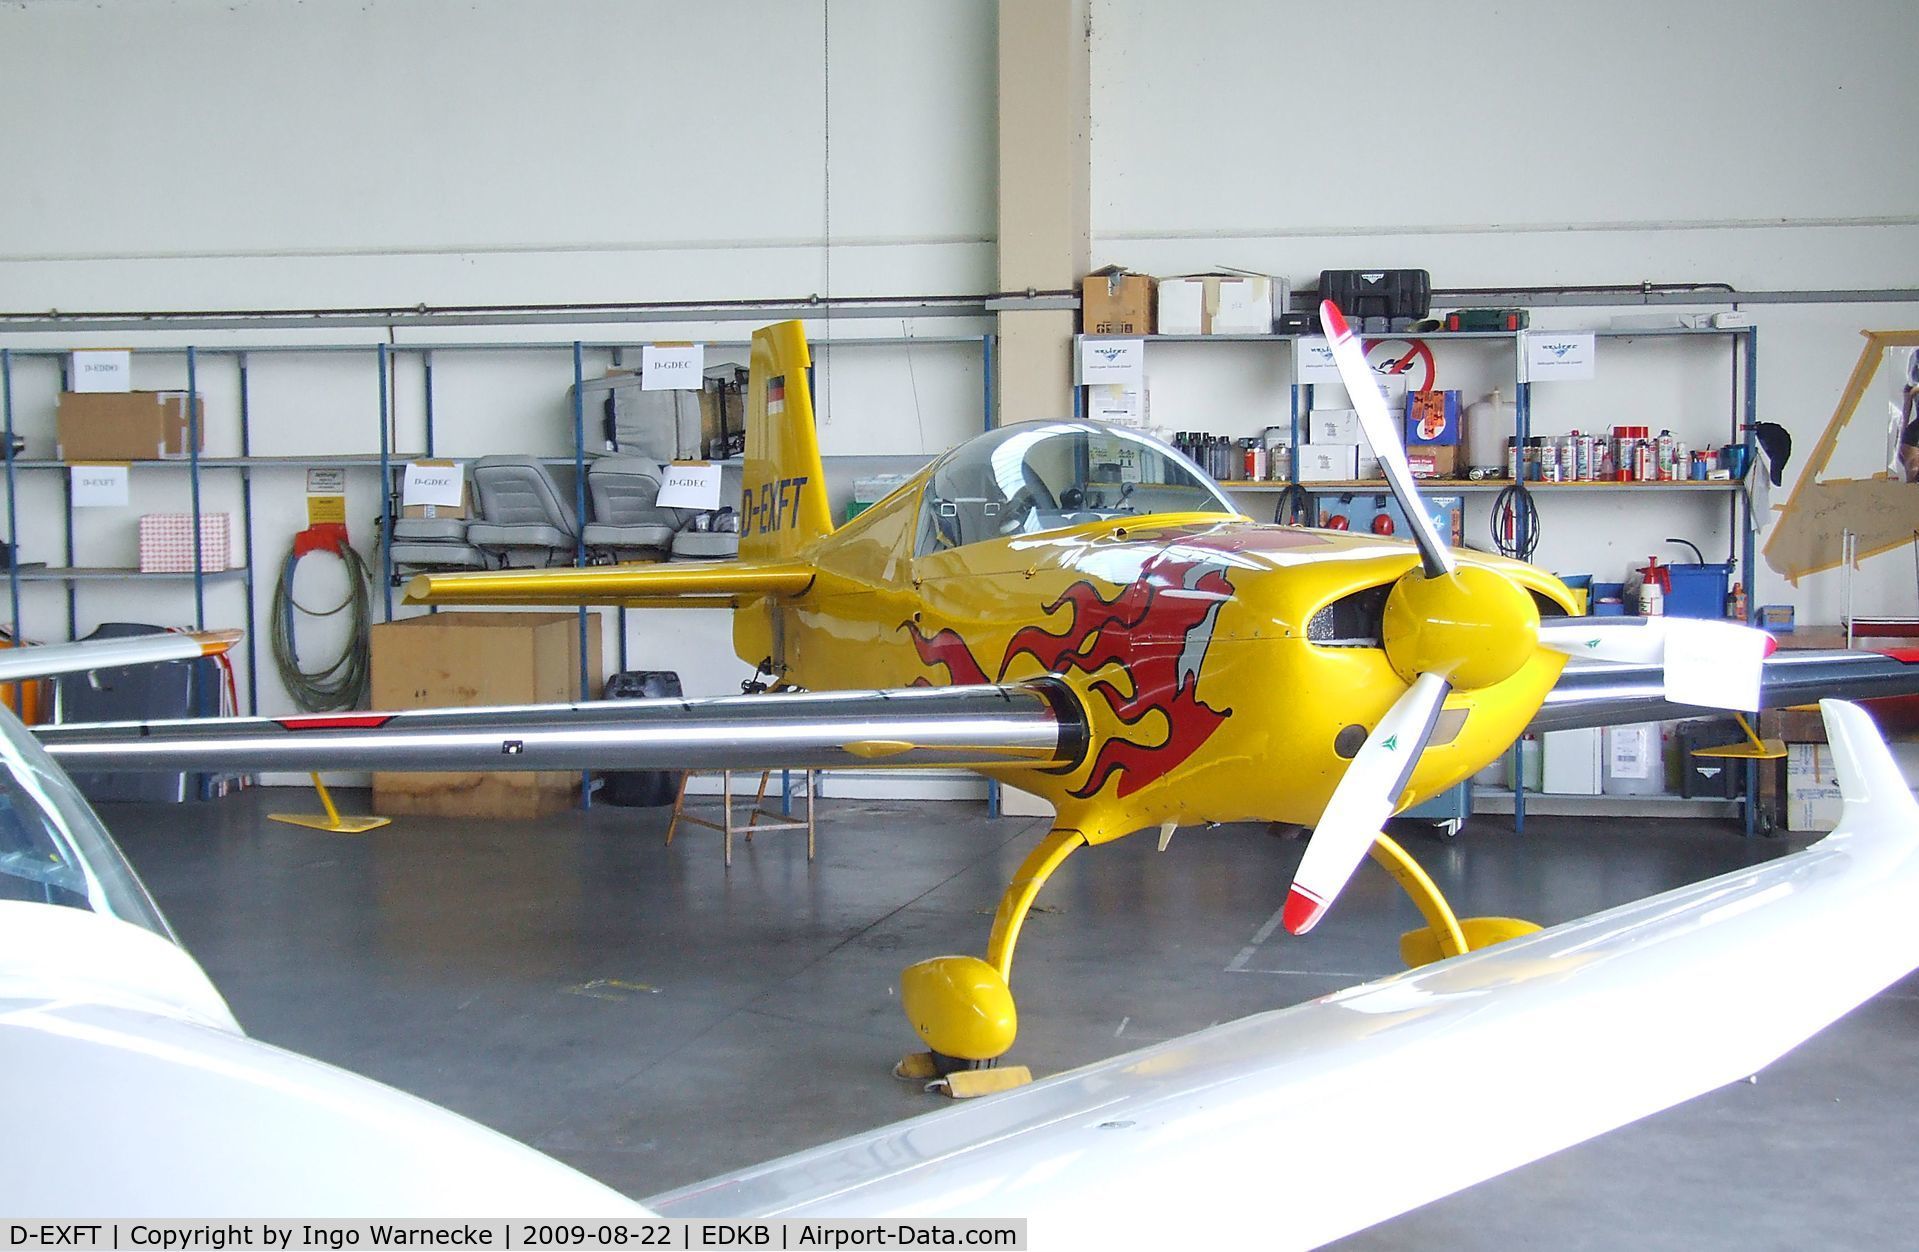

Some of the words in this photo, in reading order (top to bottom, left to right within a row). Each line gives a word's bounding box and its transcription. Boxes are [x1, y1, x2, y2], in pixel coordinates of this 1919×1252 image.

[653, 361, 692, 370] D-GDEC
[414, 478, 450, 486] D-GDEC
[669, 479, 707, 488] D-GDEC
[741, 477, 808, 539] D-EXFT
